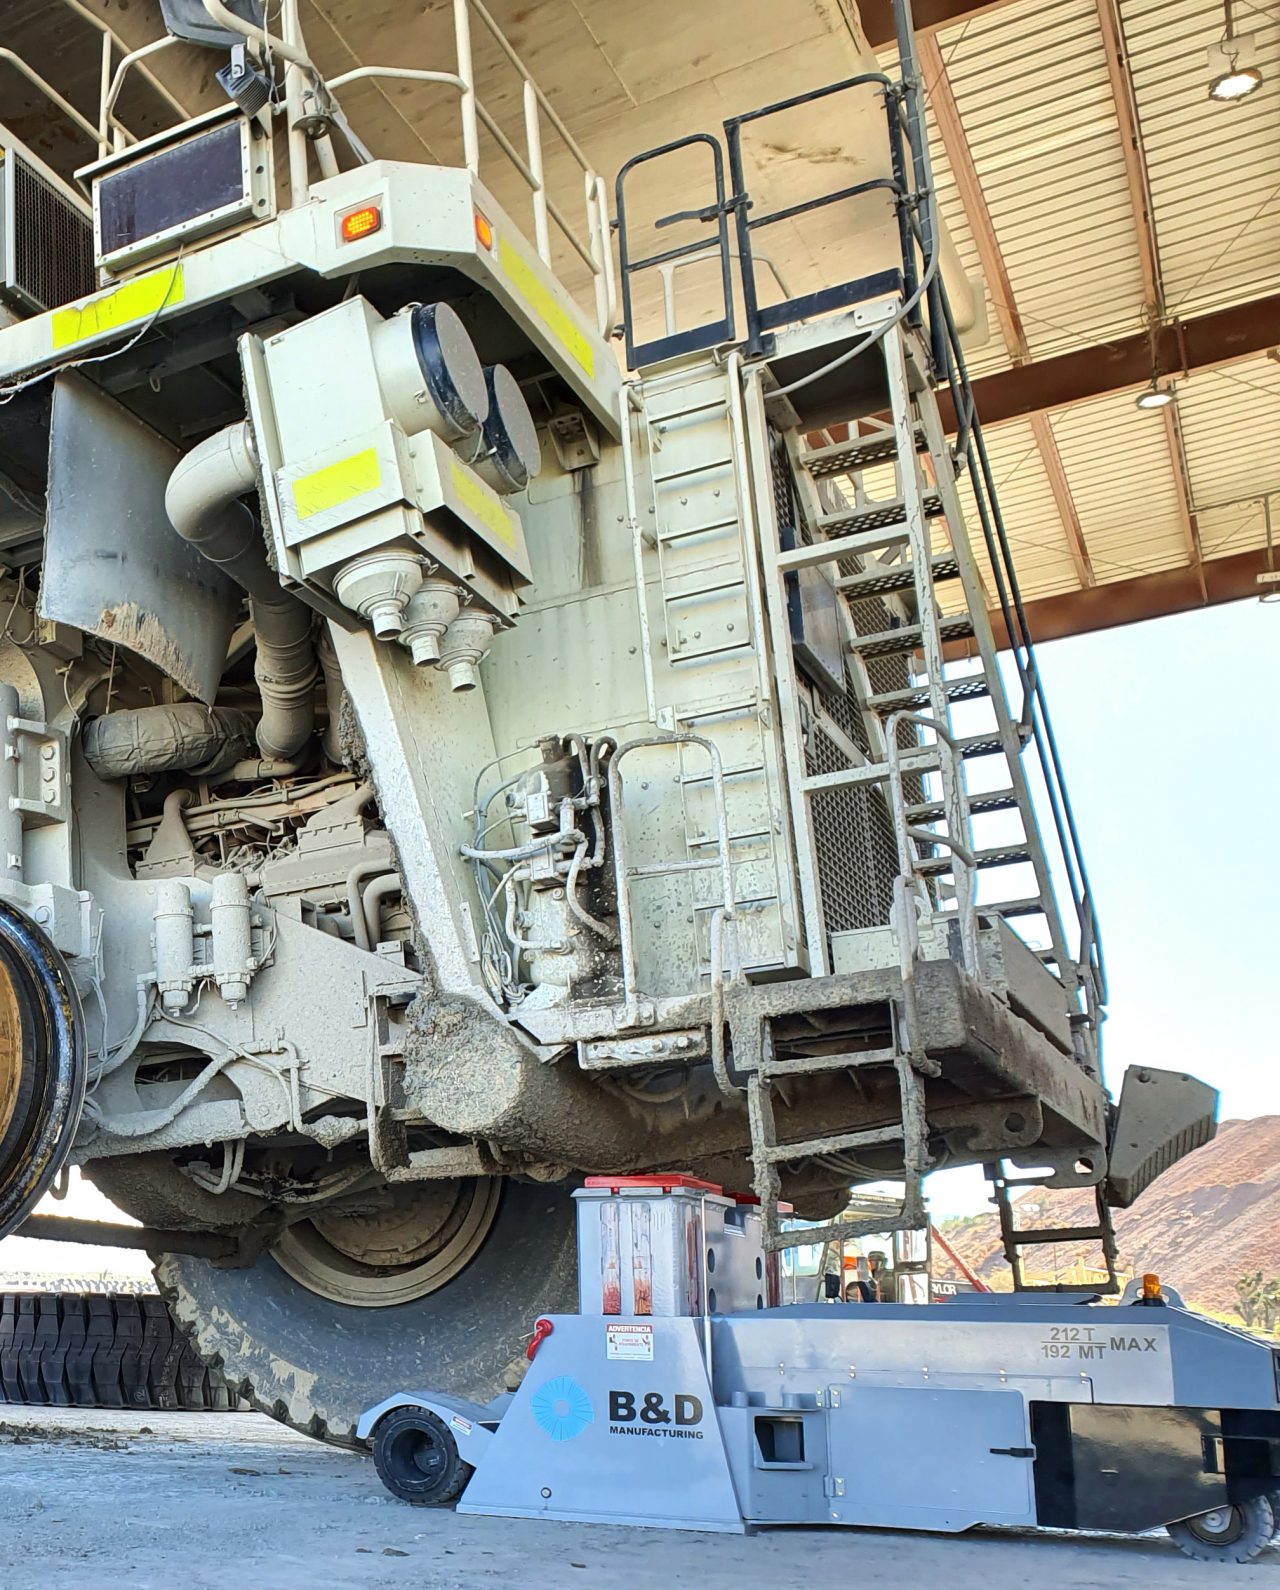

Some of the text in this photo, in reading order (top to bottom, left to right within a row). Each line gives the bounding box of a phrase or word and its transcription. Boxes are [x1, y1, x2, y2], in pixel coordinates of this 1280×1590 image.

[1050, 1327, 1096, 1341] 212 T
[1041, 1344, 1107, 1360] 192 MT
[1110, 1336, 1158, 1353] MAX
[609, 1391, 703, 1425] B&D
[609, 1426, 703, 1439] MANUFACTURING
